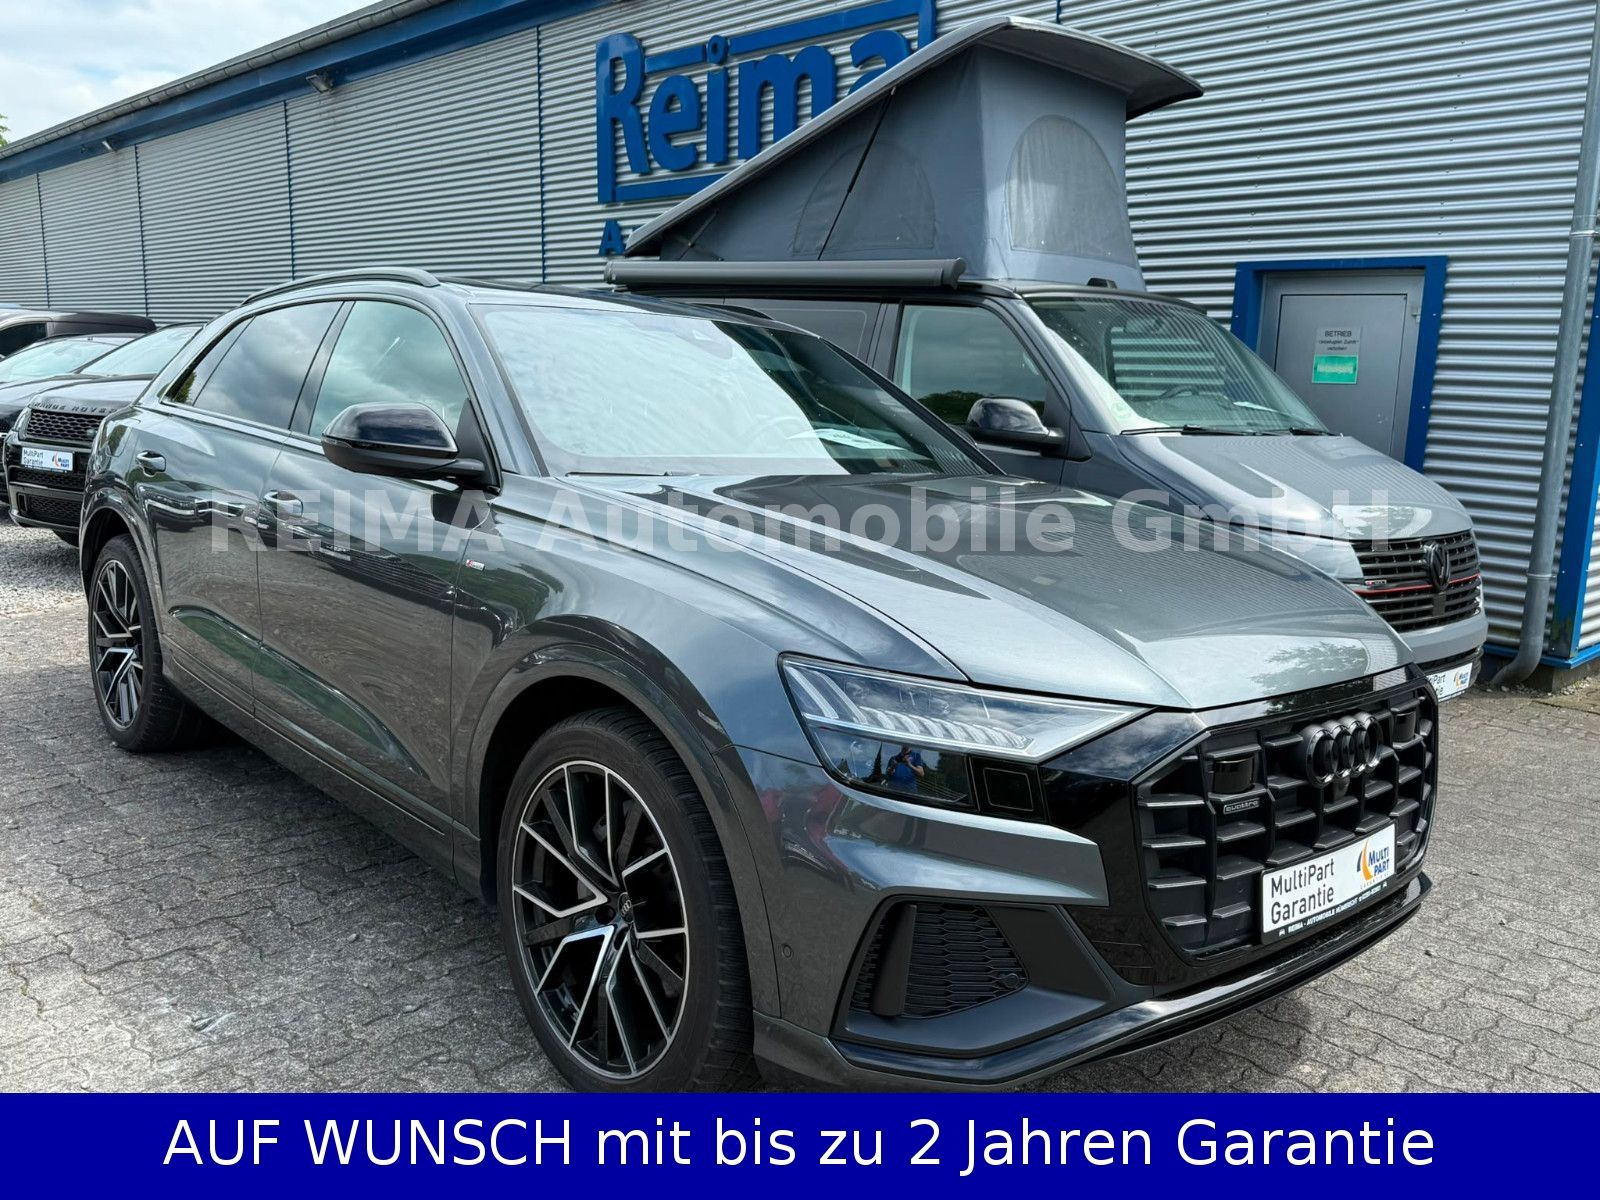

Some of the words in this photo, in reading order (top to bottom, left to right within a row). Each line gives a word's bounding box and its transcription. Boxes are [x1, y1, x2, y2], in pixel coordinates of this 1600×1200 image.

[1368, 846, 1389, 865] MULTI
[1373, 858, 1389, 877] PART
[1271, 858, 1335, 899] MultiPart
[1271, 884, 1335, 925] Garantie
